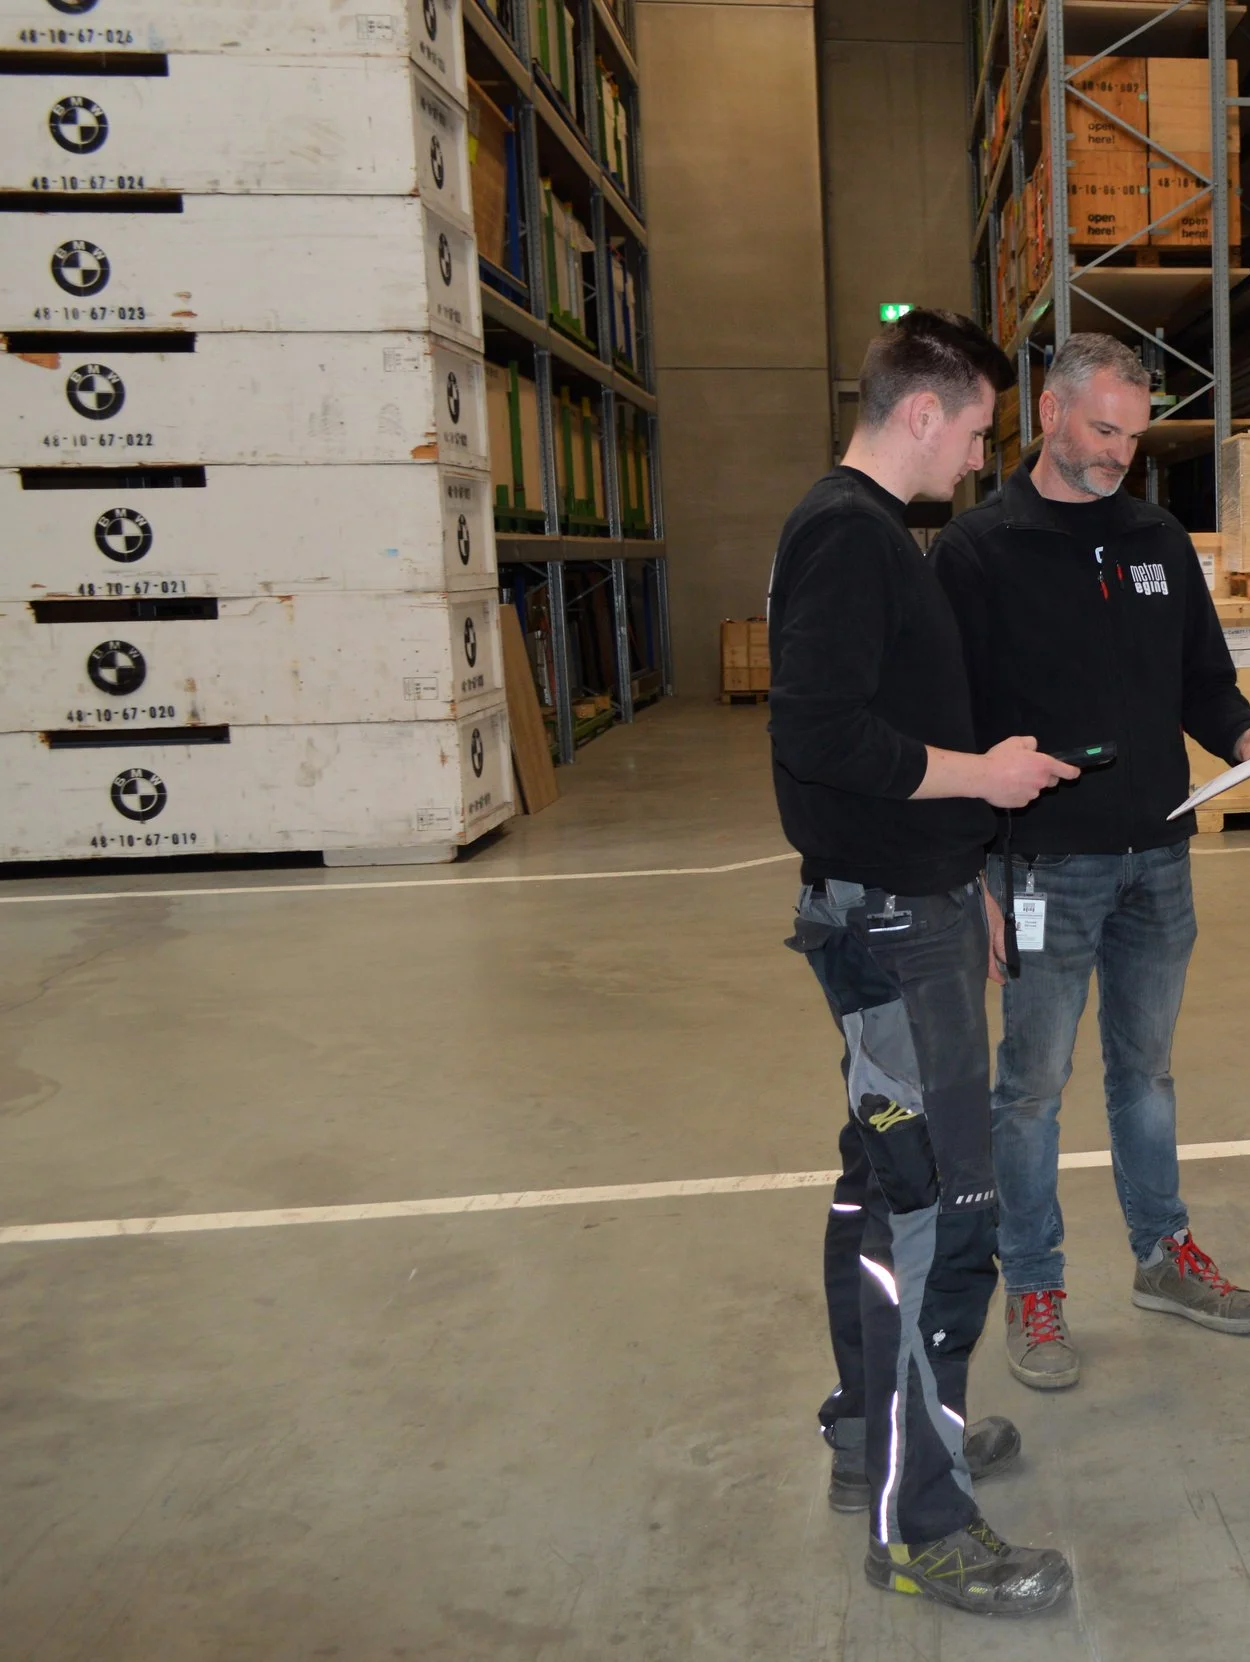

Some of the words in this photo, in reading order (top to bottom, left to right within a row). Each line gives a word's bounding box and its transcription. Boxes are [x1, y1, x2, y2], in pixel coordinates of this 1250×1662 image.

[19, 29, 134, 44] 48-10-67-026
[1088, 121, 1115, 132] open
[1088, 133, 1115, 145] here!
[31, 176, 144, 190] 48-10-67-024
[1088, 213, 1115, 223] open
[1181, 216, 1208, 227] open
[1087, 224, 1116, 236] here!
[34, 307, 145, 320] 48-10-67-023
[43, 434, 154, 447] 48-10-67-022
[1130, 562, 1166, 582] metron
[78, 580, 186, 596] 48-10-67-021
[1135, 581, 1169, 595] eging
[67, 705, 175, 722] 48-10-67-020
[91, 833, 197, 848] 48-10-67-019
